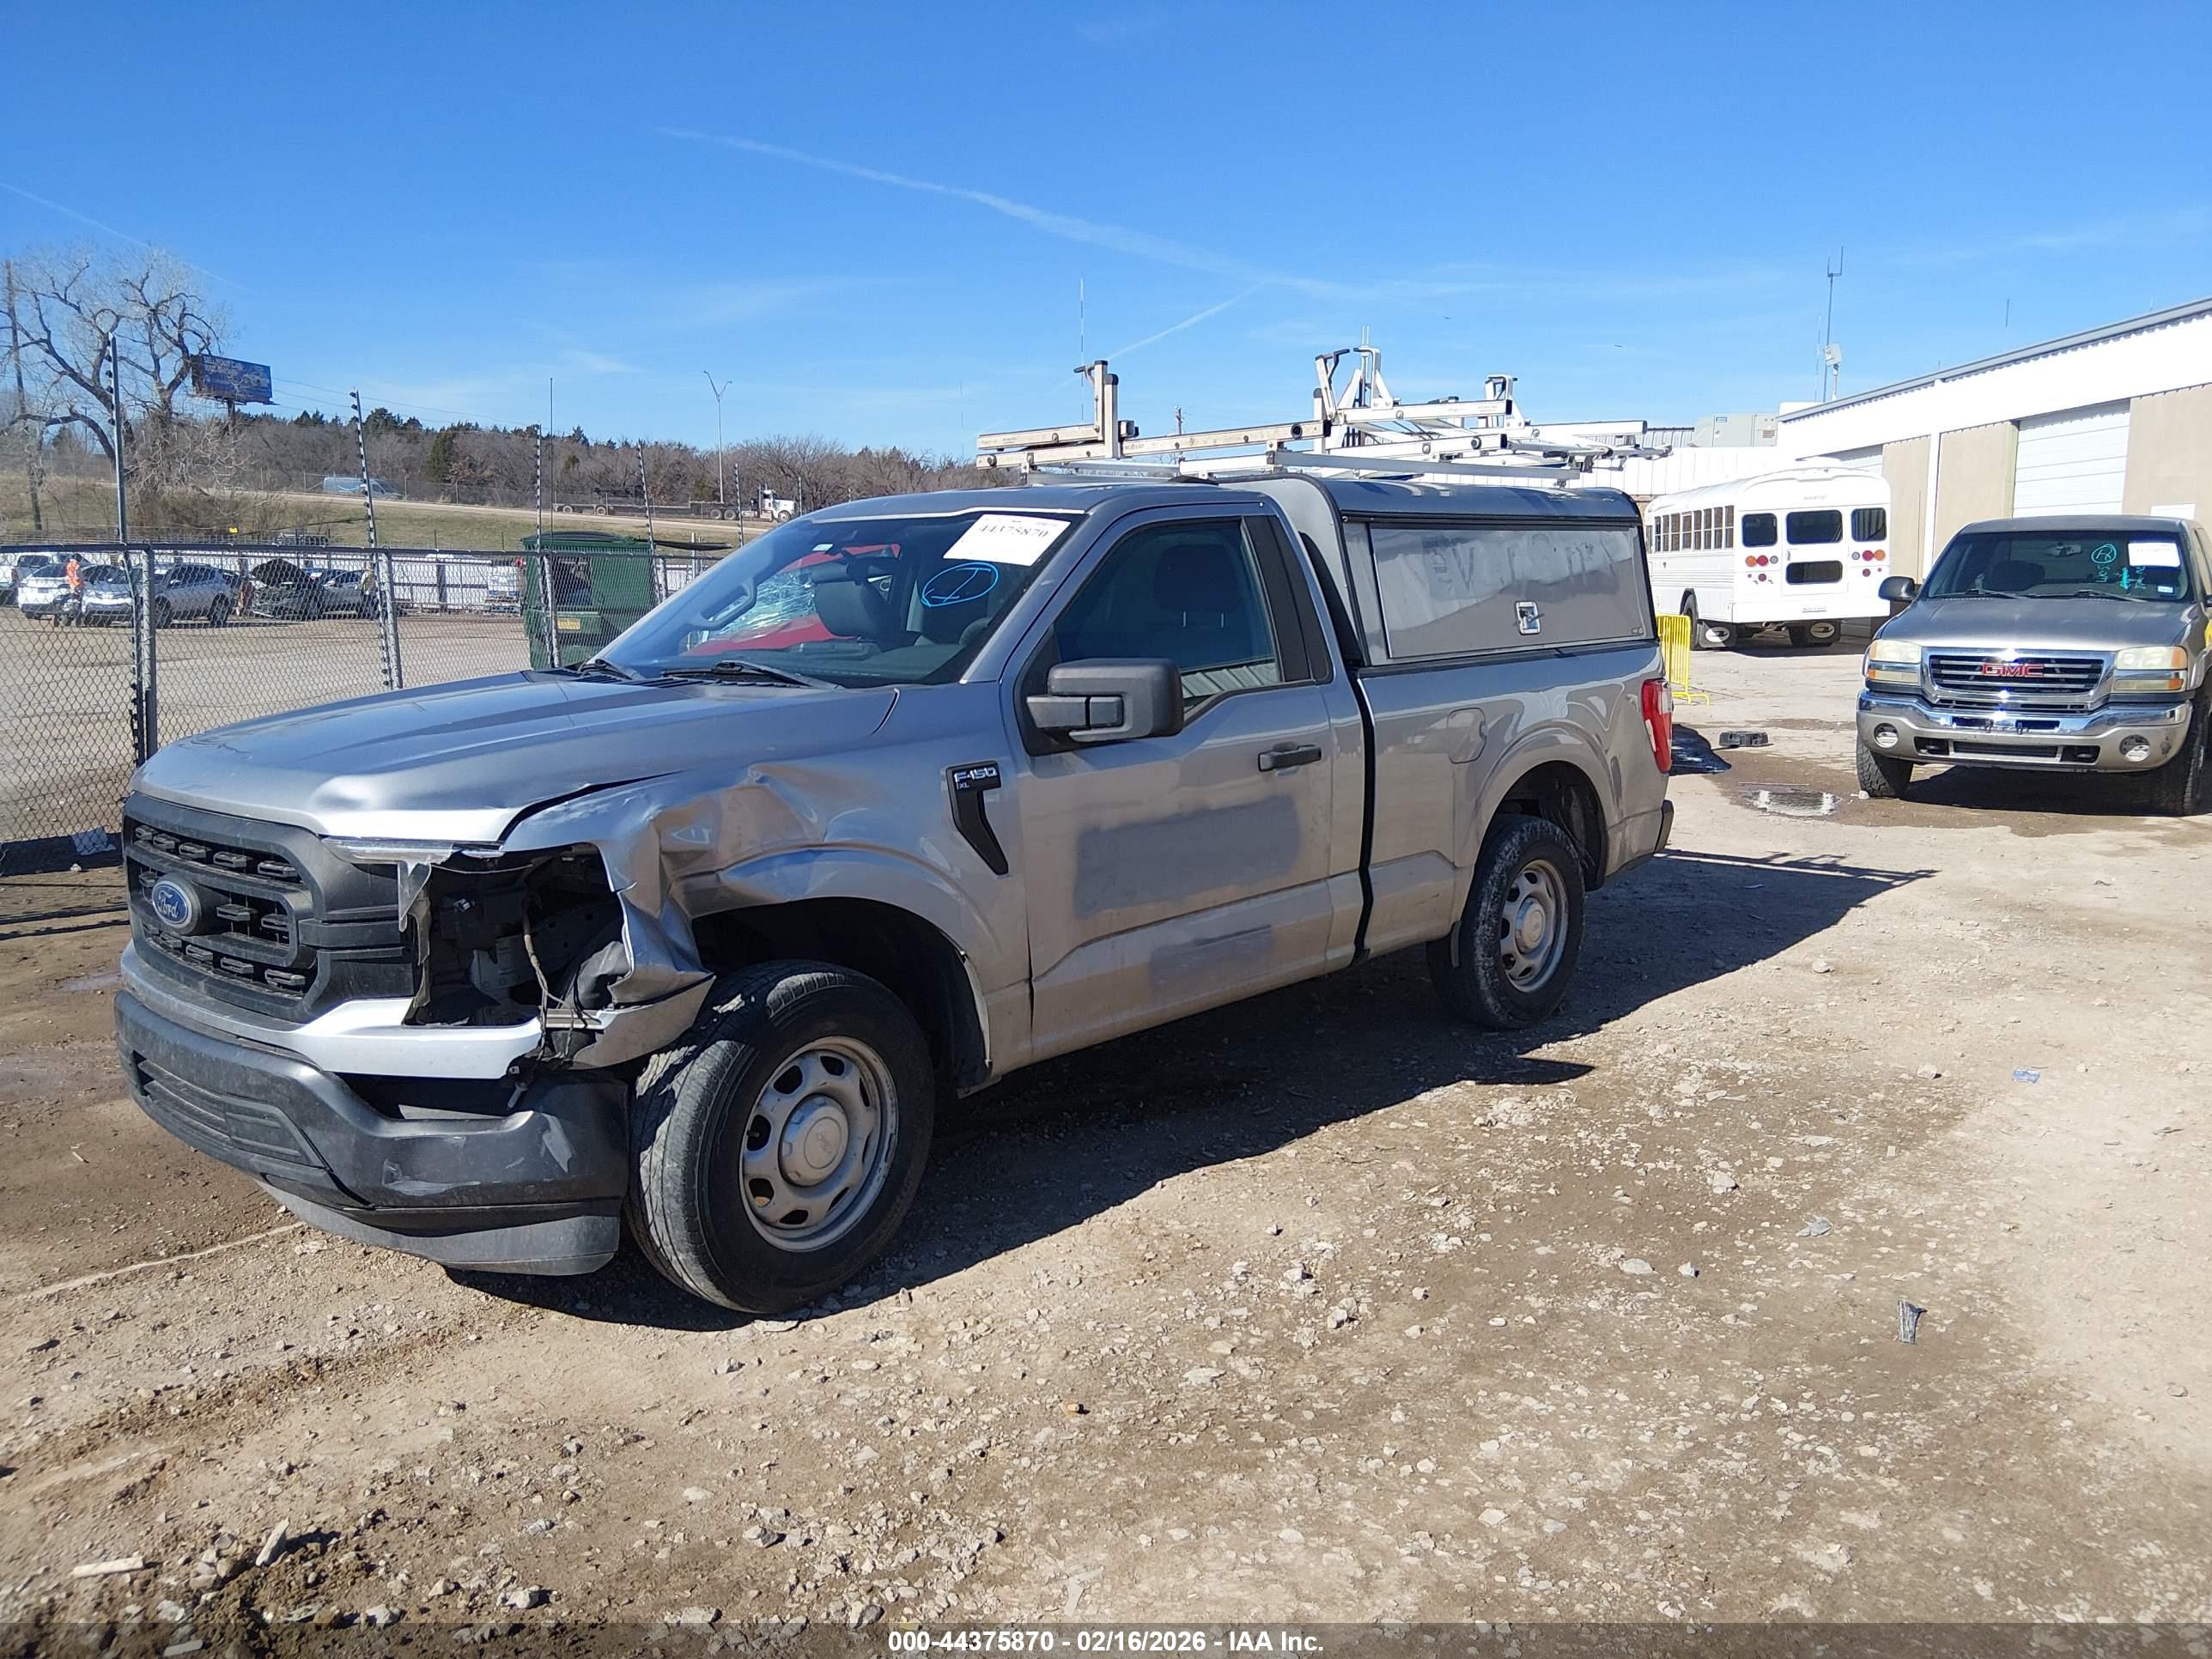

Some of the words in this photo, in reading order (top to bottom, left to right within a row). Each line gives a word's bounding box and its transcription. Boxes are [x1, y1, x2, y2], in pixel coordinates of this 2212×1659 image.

[979, 525, 1048, 537] 44375870
[1980, 663, 2045, 678] GMC
[954, 767, 998, 783] F-150
[157, 890, 179, 919] Ford
